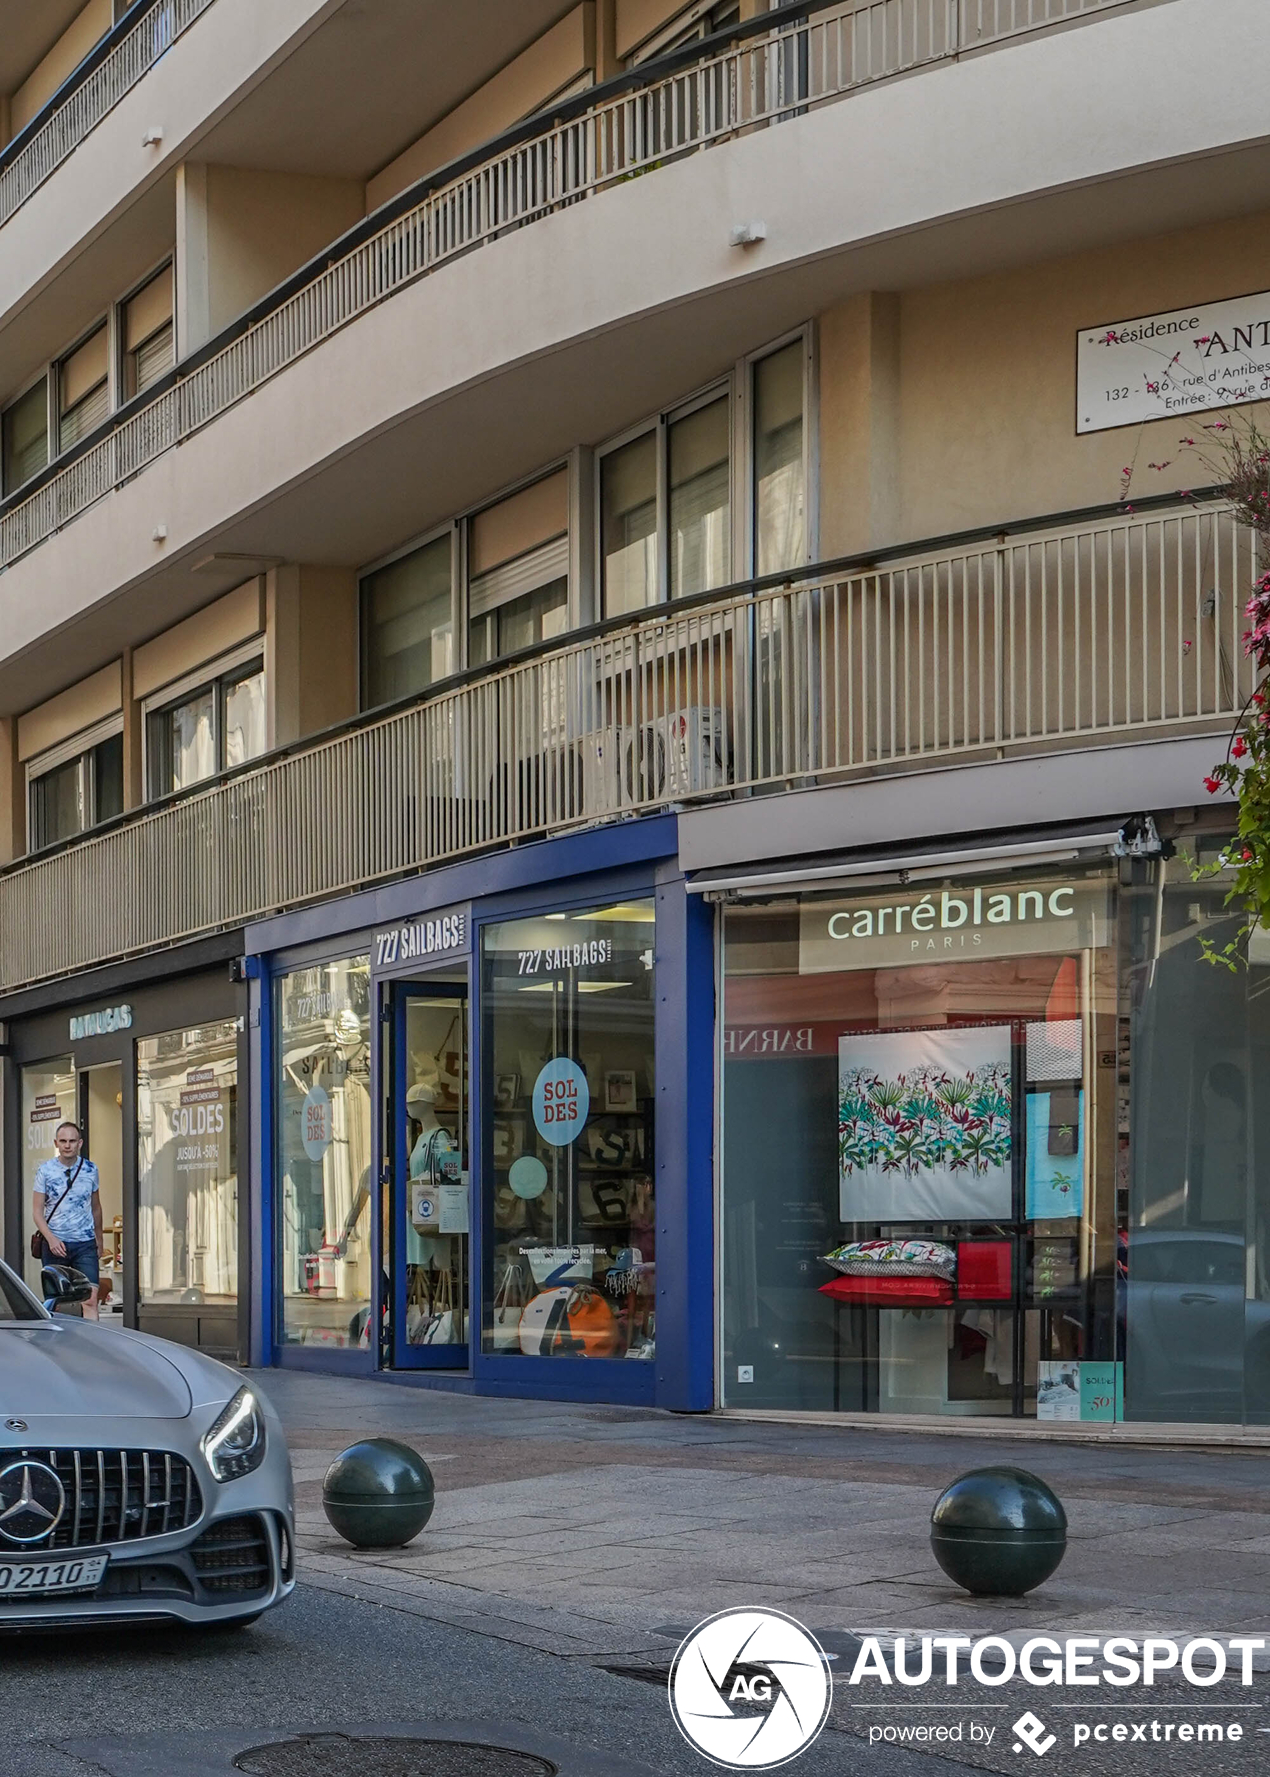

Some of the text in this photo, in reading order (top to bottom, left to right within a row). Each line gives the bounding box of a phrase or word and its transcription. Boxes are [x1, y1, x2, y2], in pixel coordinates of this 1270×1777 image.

[1105, 316, 1200, 347] Résidence
[1105, 387, 1129, 401] 132
[1183, 376, 1204, 387] rue
[1208, 362, 1270, 382] d'Antibes
[827, 887, 1075, 940] carréblanc
[376, 915, 459, 966] 727 SAILBAGS
[911, 934, 981, 951] PARIS
[518, 939, 606, 975] 727 SAILBAGS
[70, 1004, 132, 1041] PATAUGAS
[544, 1079, 578, 1101] SOL
[172, 1104, 224, 1137] SOLDES
[307, 1104, 325, 1122] SOL
[544, 1101, 578, 1123] DES
[307, 1124, 325, 1142] DES
[177, 1141, 202, 1160] JUSQU'À
[15, 1562, 84, 1588] 2110
